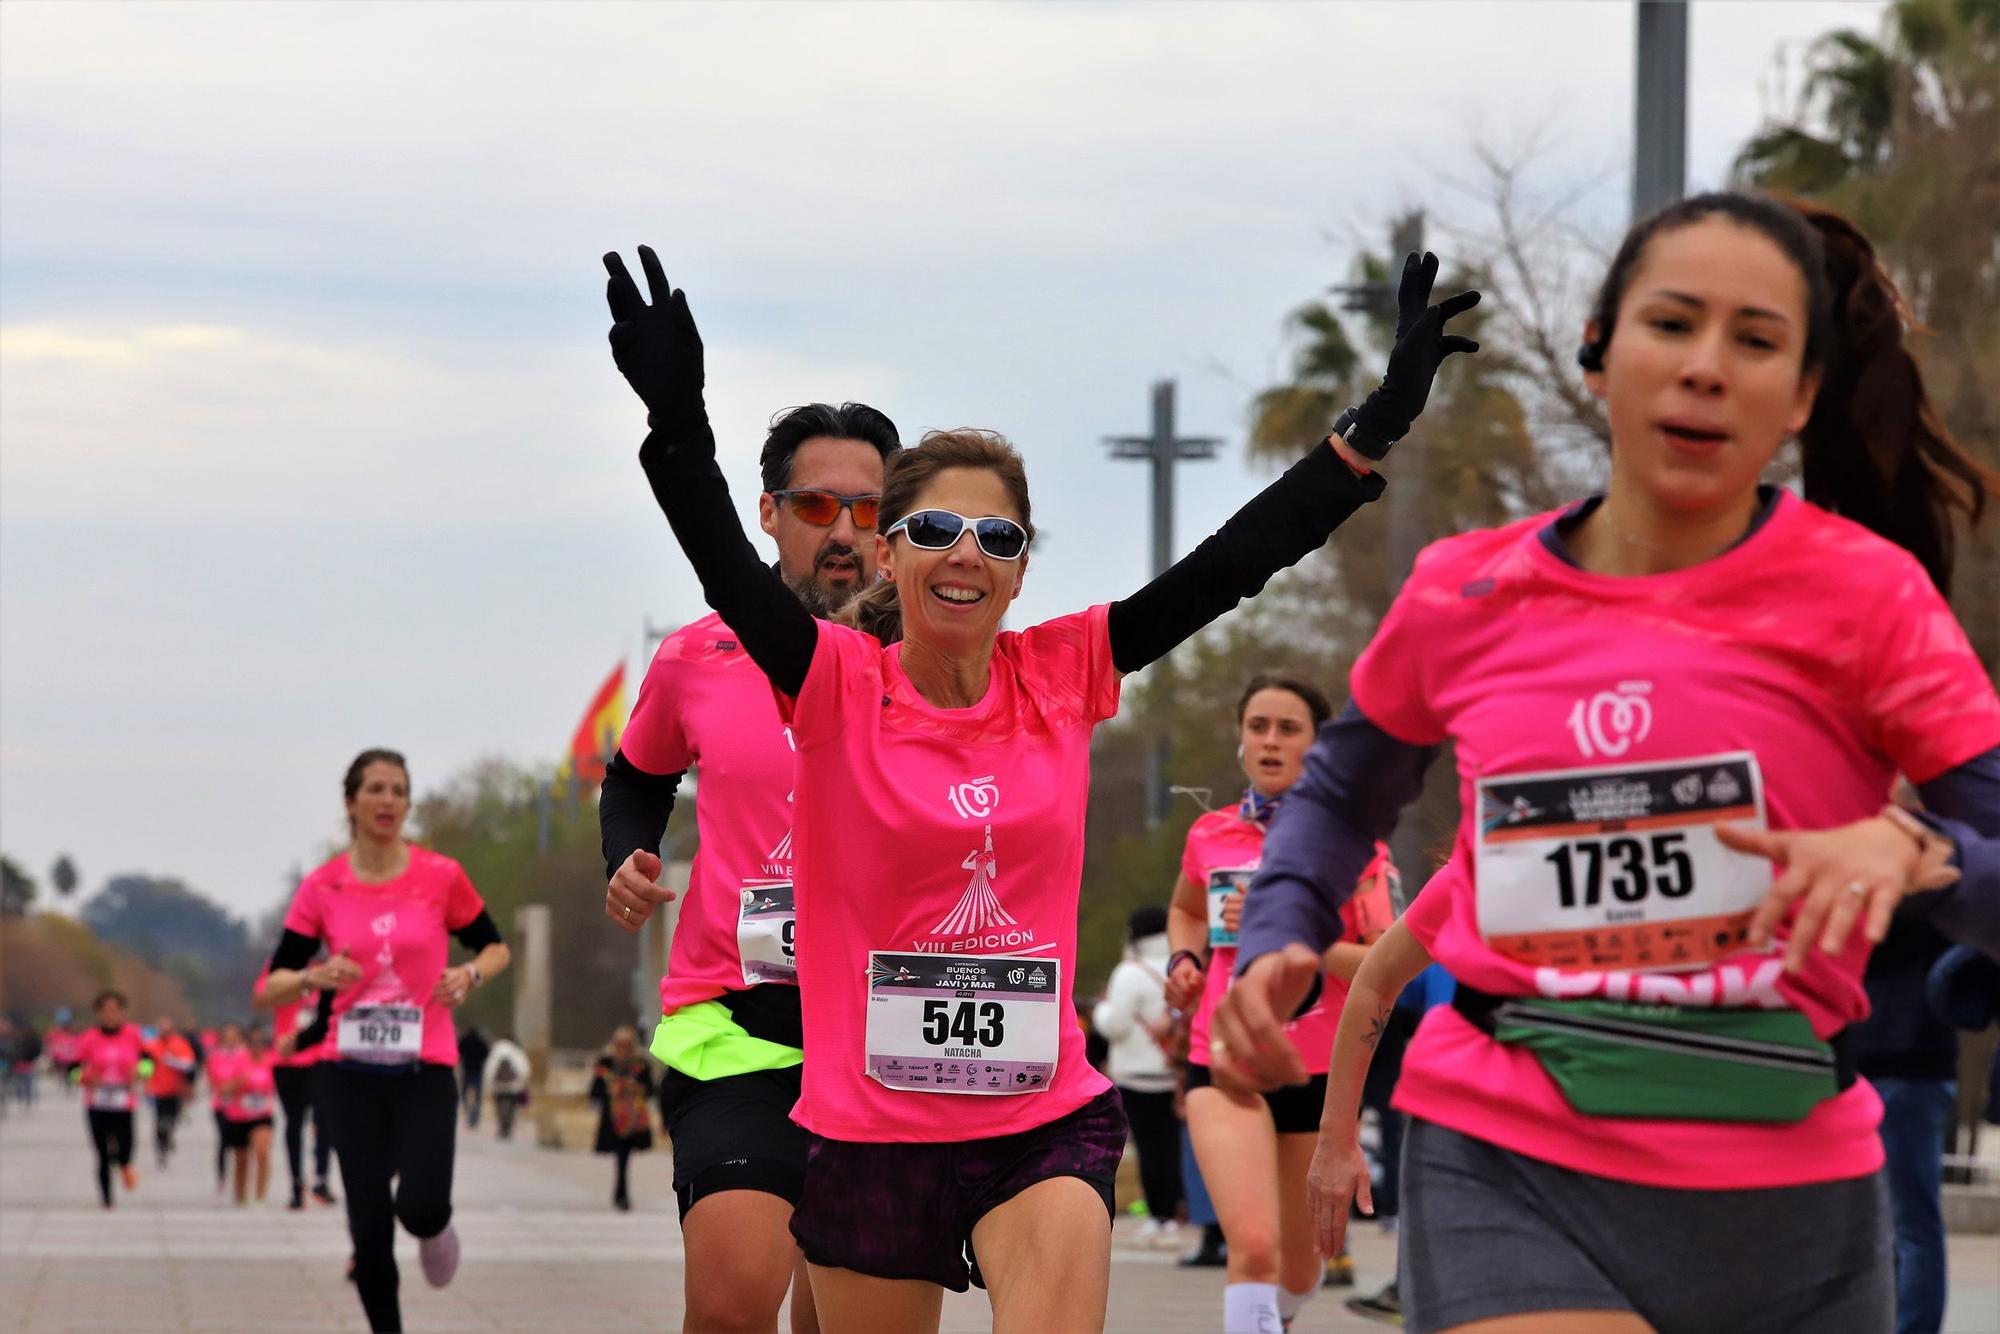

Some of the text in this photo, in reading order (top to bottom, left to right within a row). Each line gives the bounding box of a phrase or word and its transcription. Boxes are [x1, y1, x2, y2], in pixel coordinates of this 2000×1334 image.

[1546, 831, 1694, 908] 1735
[912, 929, 1034, 953] VIII EDICIÓN
[946, 966, 987, 975] BUENOS
[955, 973, 978, 981] DÍAS
[935, 980, 996, 989] JAVI y MAR
[922, 1000, 1005, 1046] 543
[944, 1047, 982, 1058] NATACHA
